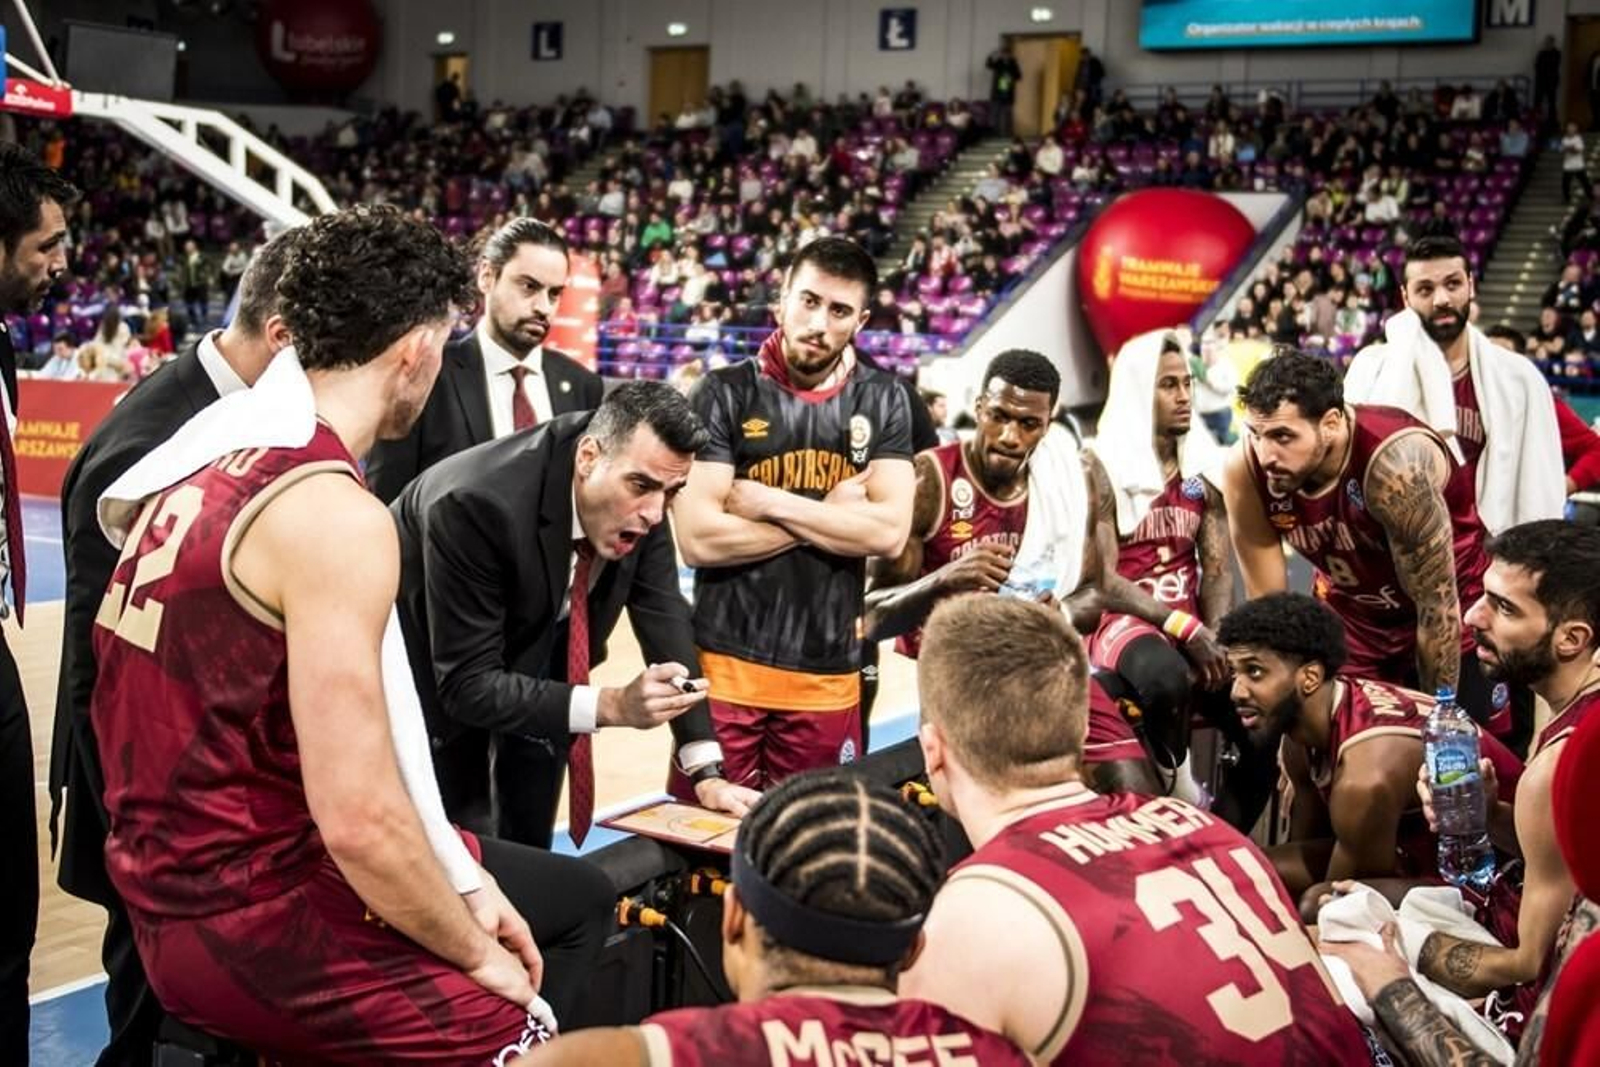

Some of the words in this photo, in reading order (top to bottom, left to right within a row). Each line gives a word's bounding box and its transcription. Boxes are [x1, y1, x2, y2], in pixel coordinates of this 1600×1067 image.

[1490, 0, 1530, 25] M
[540, 30, 556, 57] L
[885, 18, 909, 47] Ł
[1121, 256, 1201, 278] TRAMWAJE
[1326, 554, 1360, 587] 8
[1039, 796, 1213, 865] HUMMER
[1135, 847, 1345, 1043] 34
